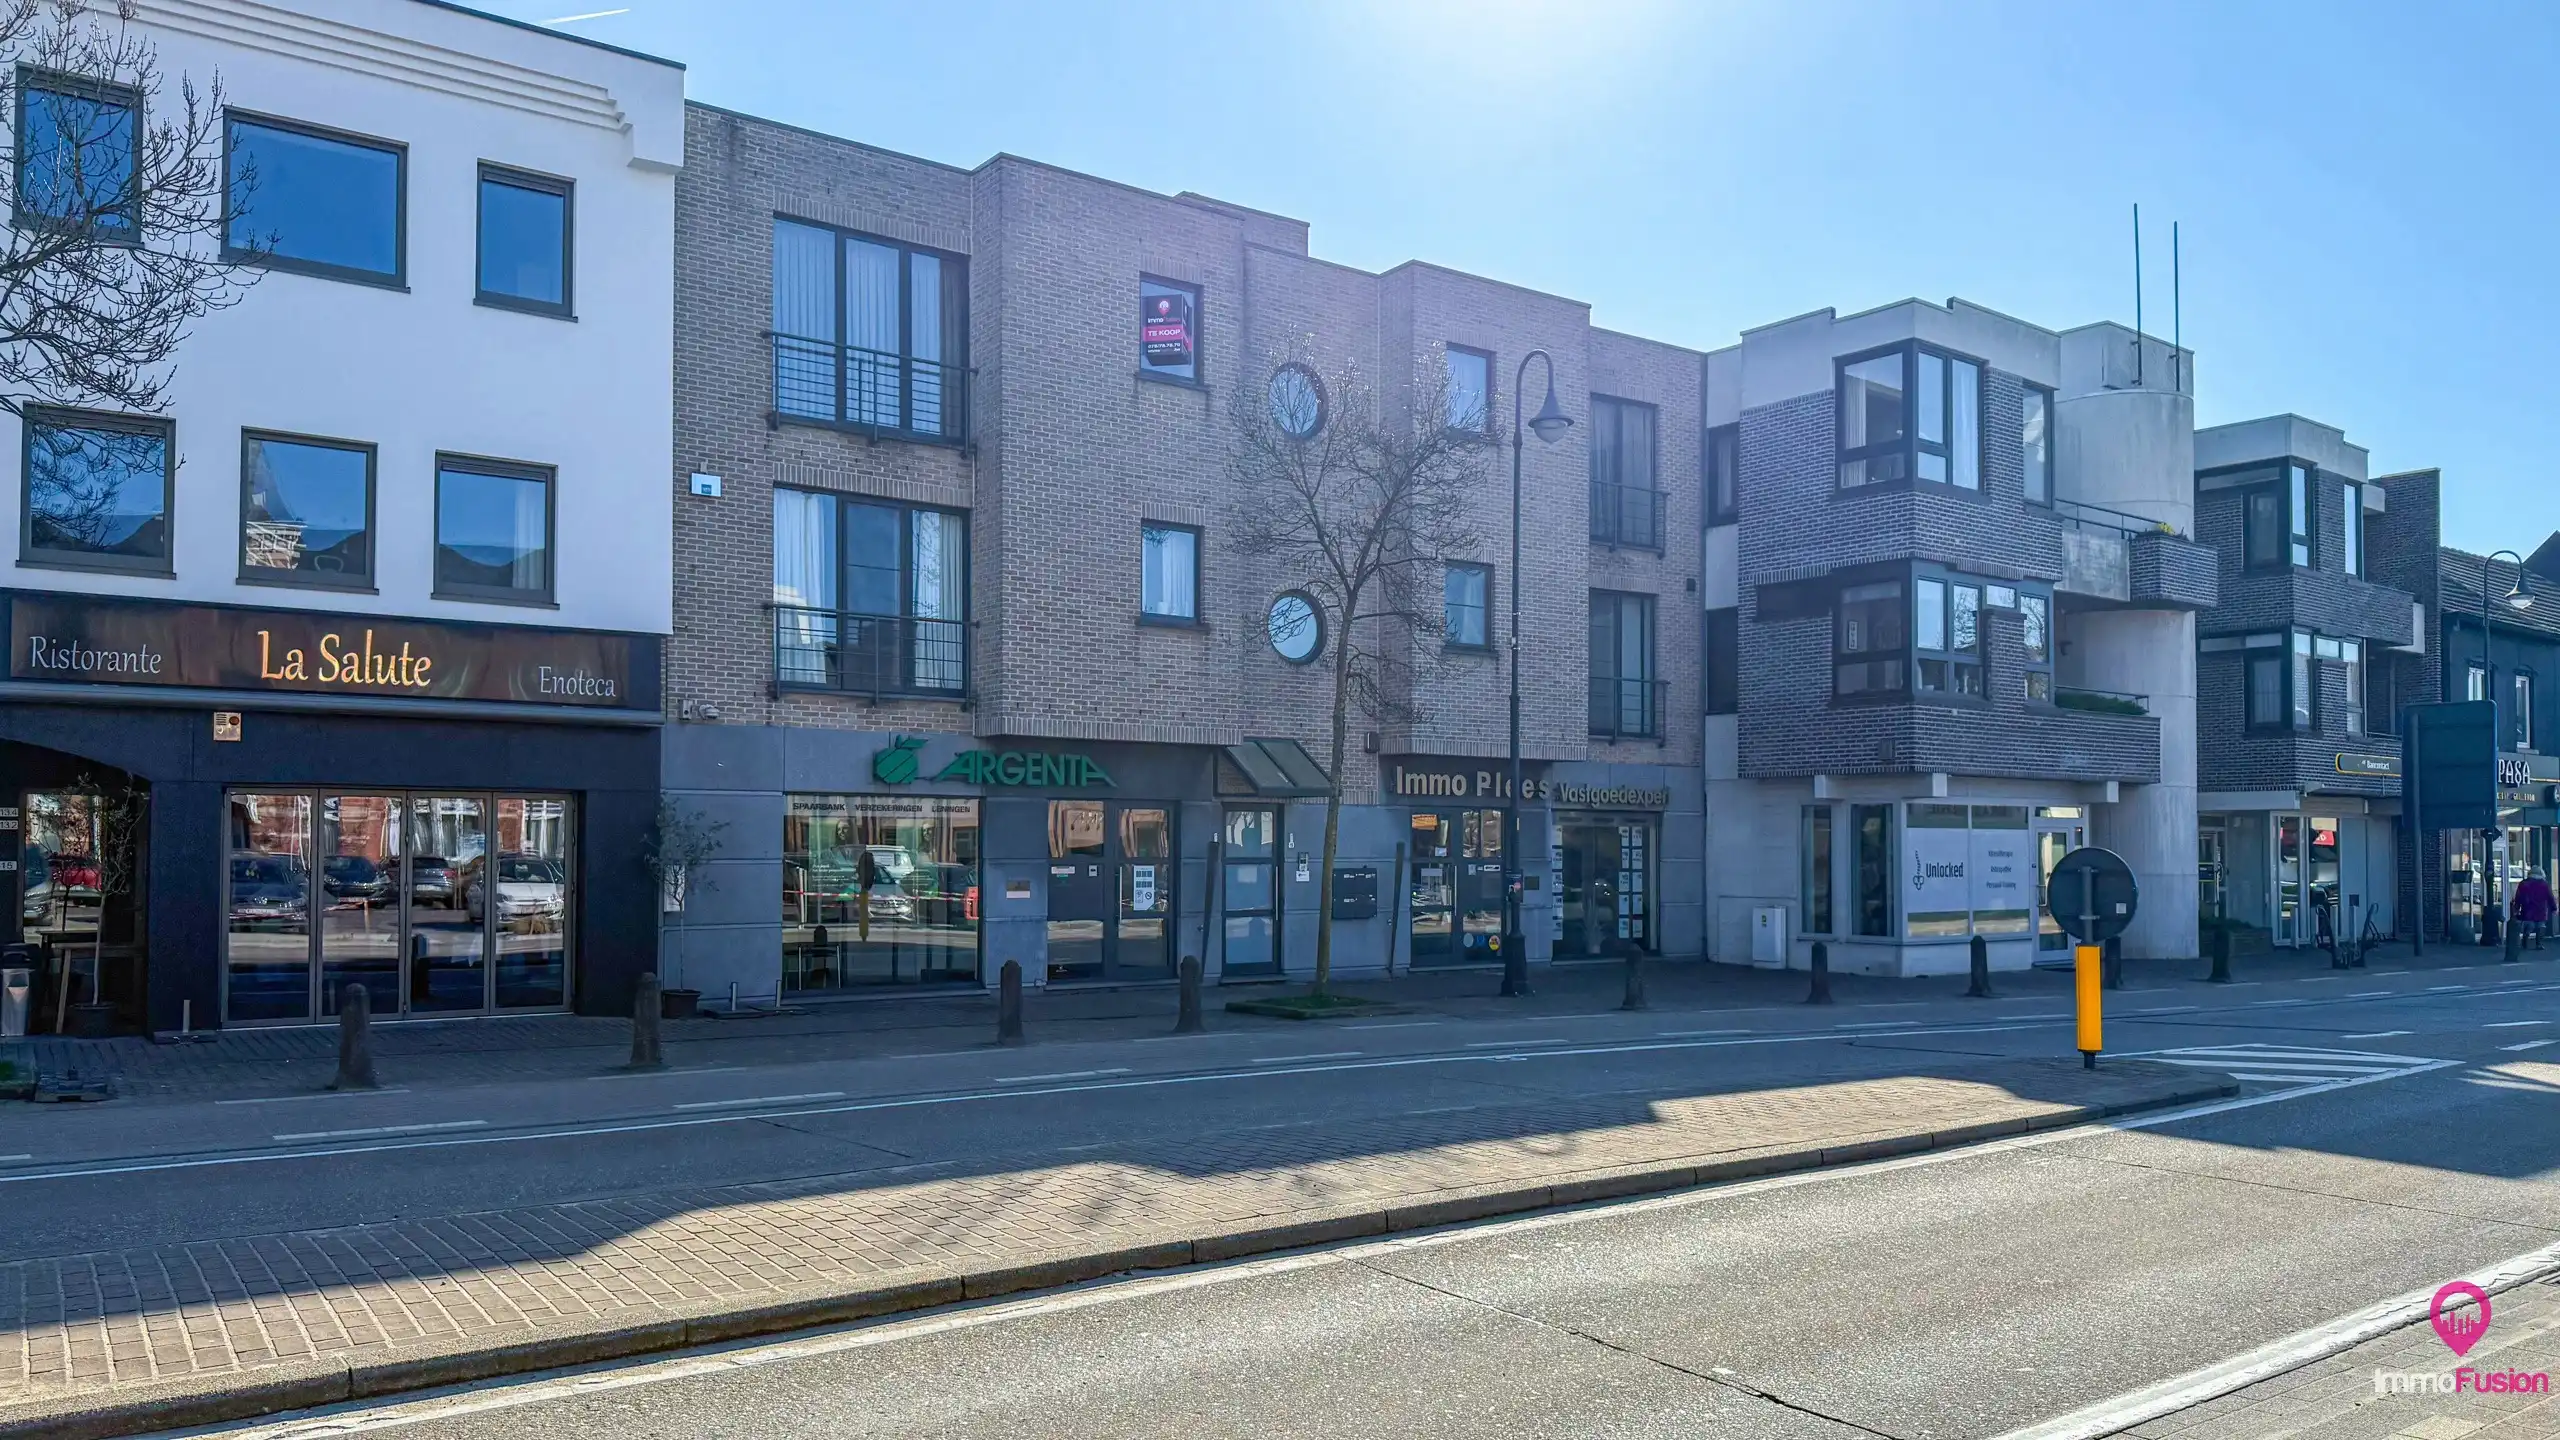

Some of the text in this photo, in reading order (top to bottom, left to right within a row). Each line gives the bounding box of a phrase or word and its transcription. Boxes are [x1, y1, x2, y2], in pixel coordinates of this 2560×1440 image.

[30, 636, 161, 674] Ristorante
[258, 629, 431, 686] La Salute
[539, 666, 616, 697] Enoteca
[933, 750, 1118, 788] ARGENTA
[1396, 766, 1467, 797] Immo
[792, 802, 846, 811] SPAARBANK
[854, 804, 923, 813] VERZEKERINGEN
[1559, 783, 1669, 808] Vastgoedexper
[1926, 862, 1964, 878] Unlocked
